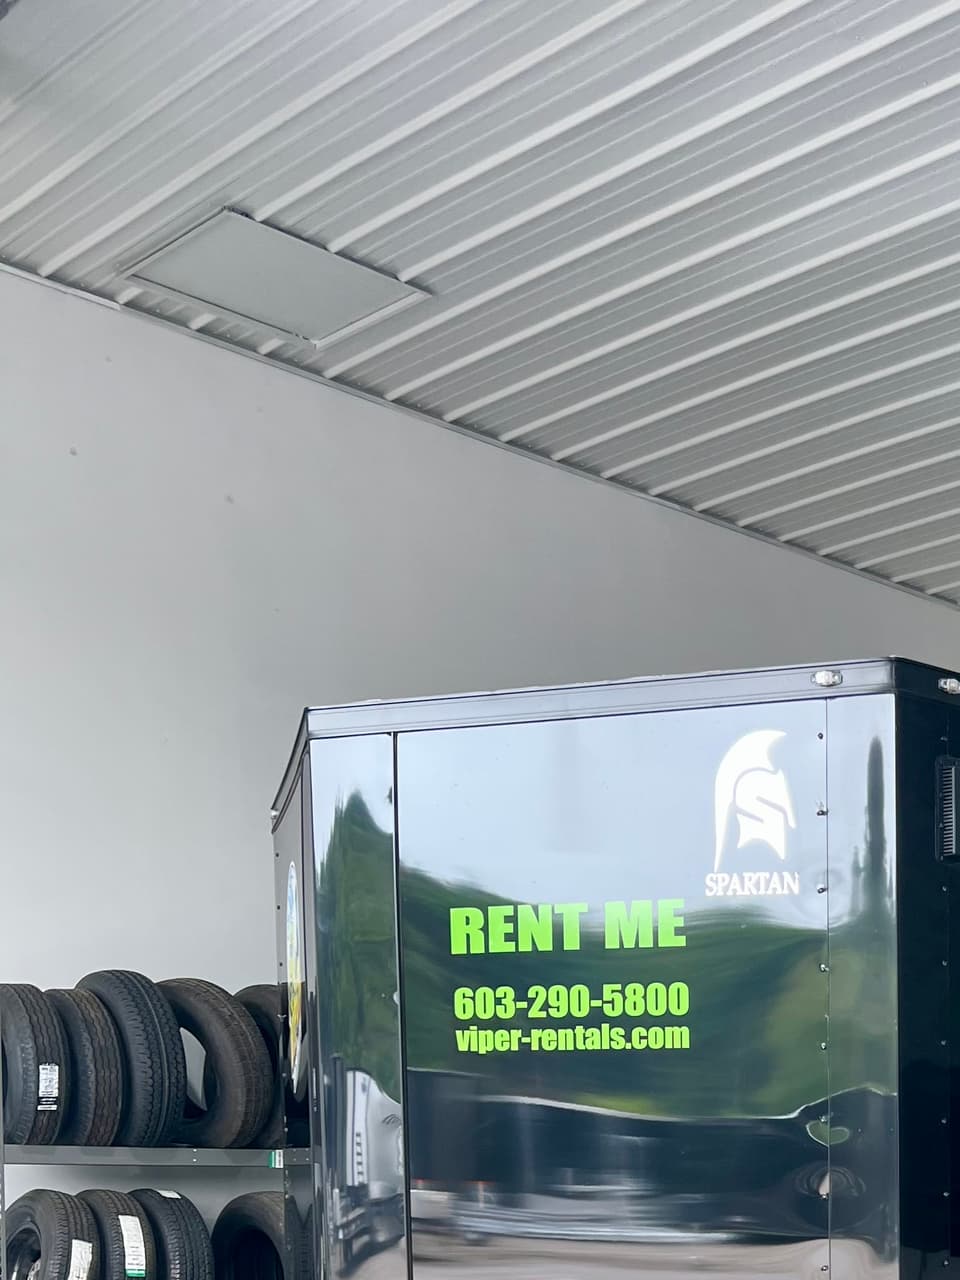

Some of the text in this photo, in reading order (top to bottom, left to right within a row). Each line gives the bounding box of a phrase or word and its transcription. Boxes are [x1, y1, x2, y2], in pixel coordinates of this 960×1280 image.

[705, 871, 800, 896] SPARTAN
[450, 899, 687, 954] RENT ME
[454, 982, 690, 1020] 603-290-5800
[455, 1024, 690, 1054] viper-rentals.com
